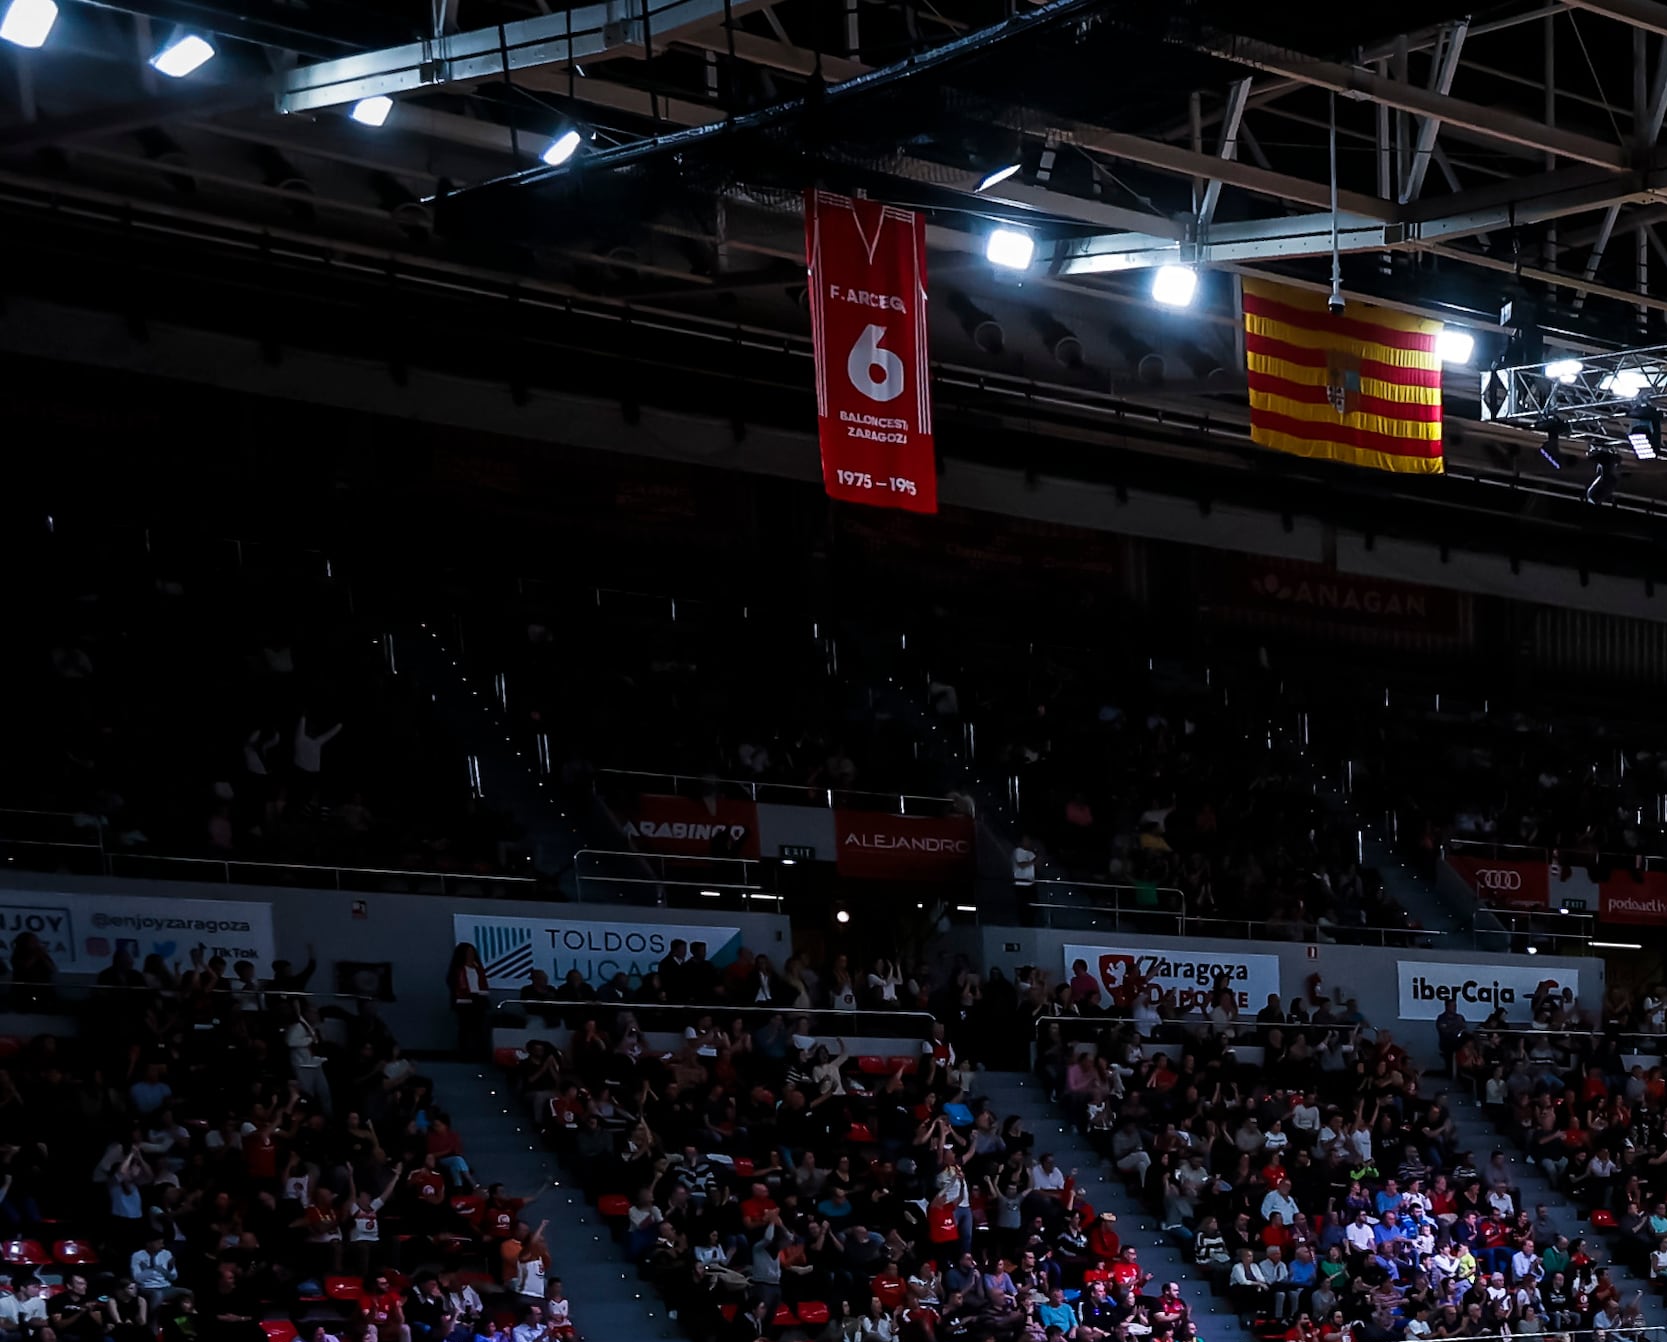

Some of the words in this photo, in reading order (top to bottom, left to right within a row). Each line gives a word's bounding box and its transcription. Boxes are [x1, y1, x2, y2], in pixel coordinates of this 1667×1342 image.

[847, 323, 904, 402] 6
[837, 469, 872, 489] 1975
[92, 912, 251, 934] @enjoyzaragoza
[211, 946, 259, 960] TikTok
[545, 928, 666, 954] TOLDOS
[1142, 955, 1248, 986] Zaragoza
[1412, 976, 1516, 1011] iberCaja
